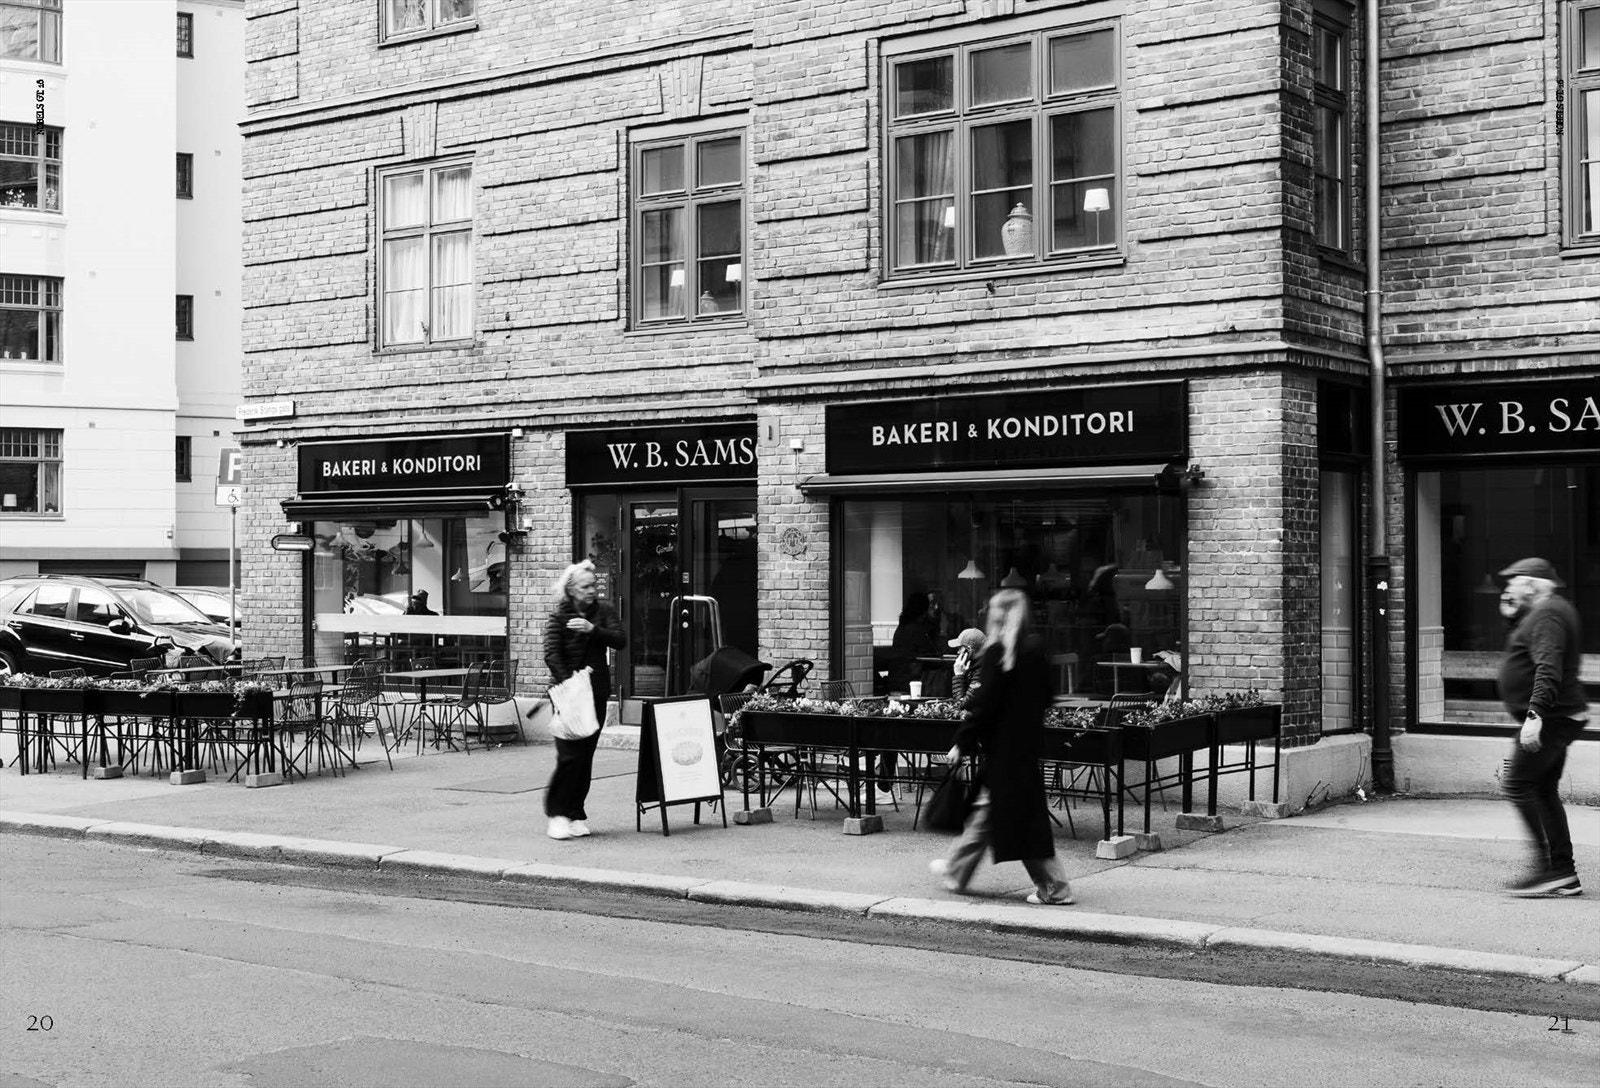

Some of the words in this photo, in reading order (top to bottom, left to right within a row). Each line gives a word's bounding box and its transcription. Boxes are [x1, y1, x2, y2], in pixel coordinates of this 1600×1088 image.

[872, 421, 958, 446] BAKERI
[967, 423, 978, 438] &
[987, 410, 1134, 439] KONDITORI
[1435, 403, 1486, 436] W.
[1499, 401, 1536, 434] B.
[322, 459, 376, 477] BAKERI
[381, 461, 388, 473] &
[392, 454, 481, 475] KONDITORI
[607, 442, 638, 469] W.
[646, 441, 669, 468] B.
[675, 437, 758, 467] SAMS
